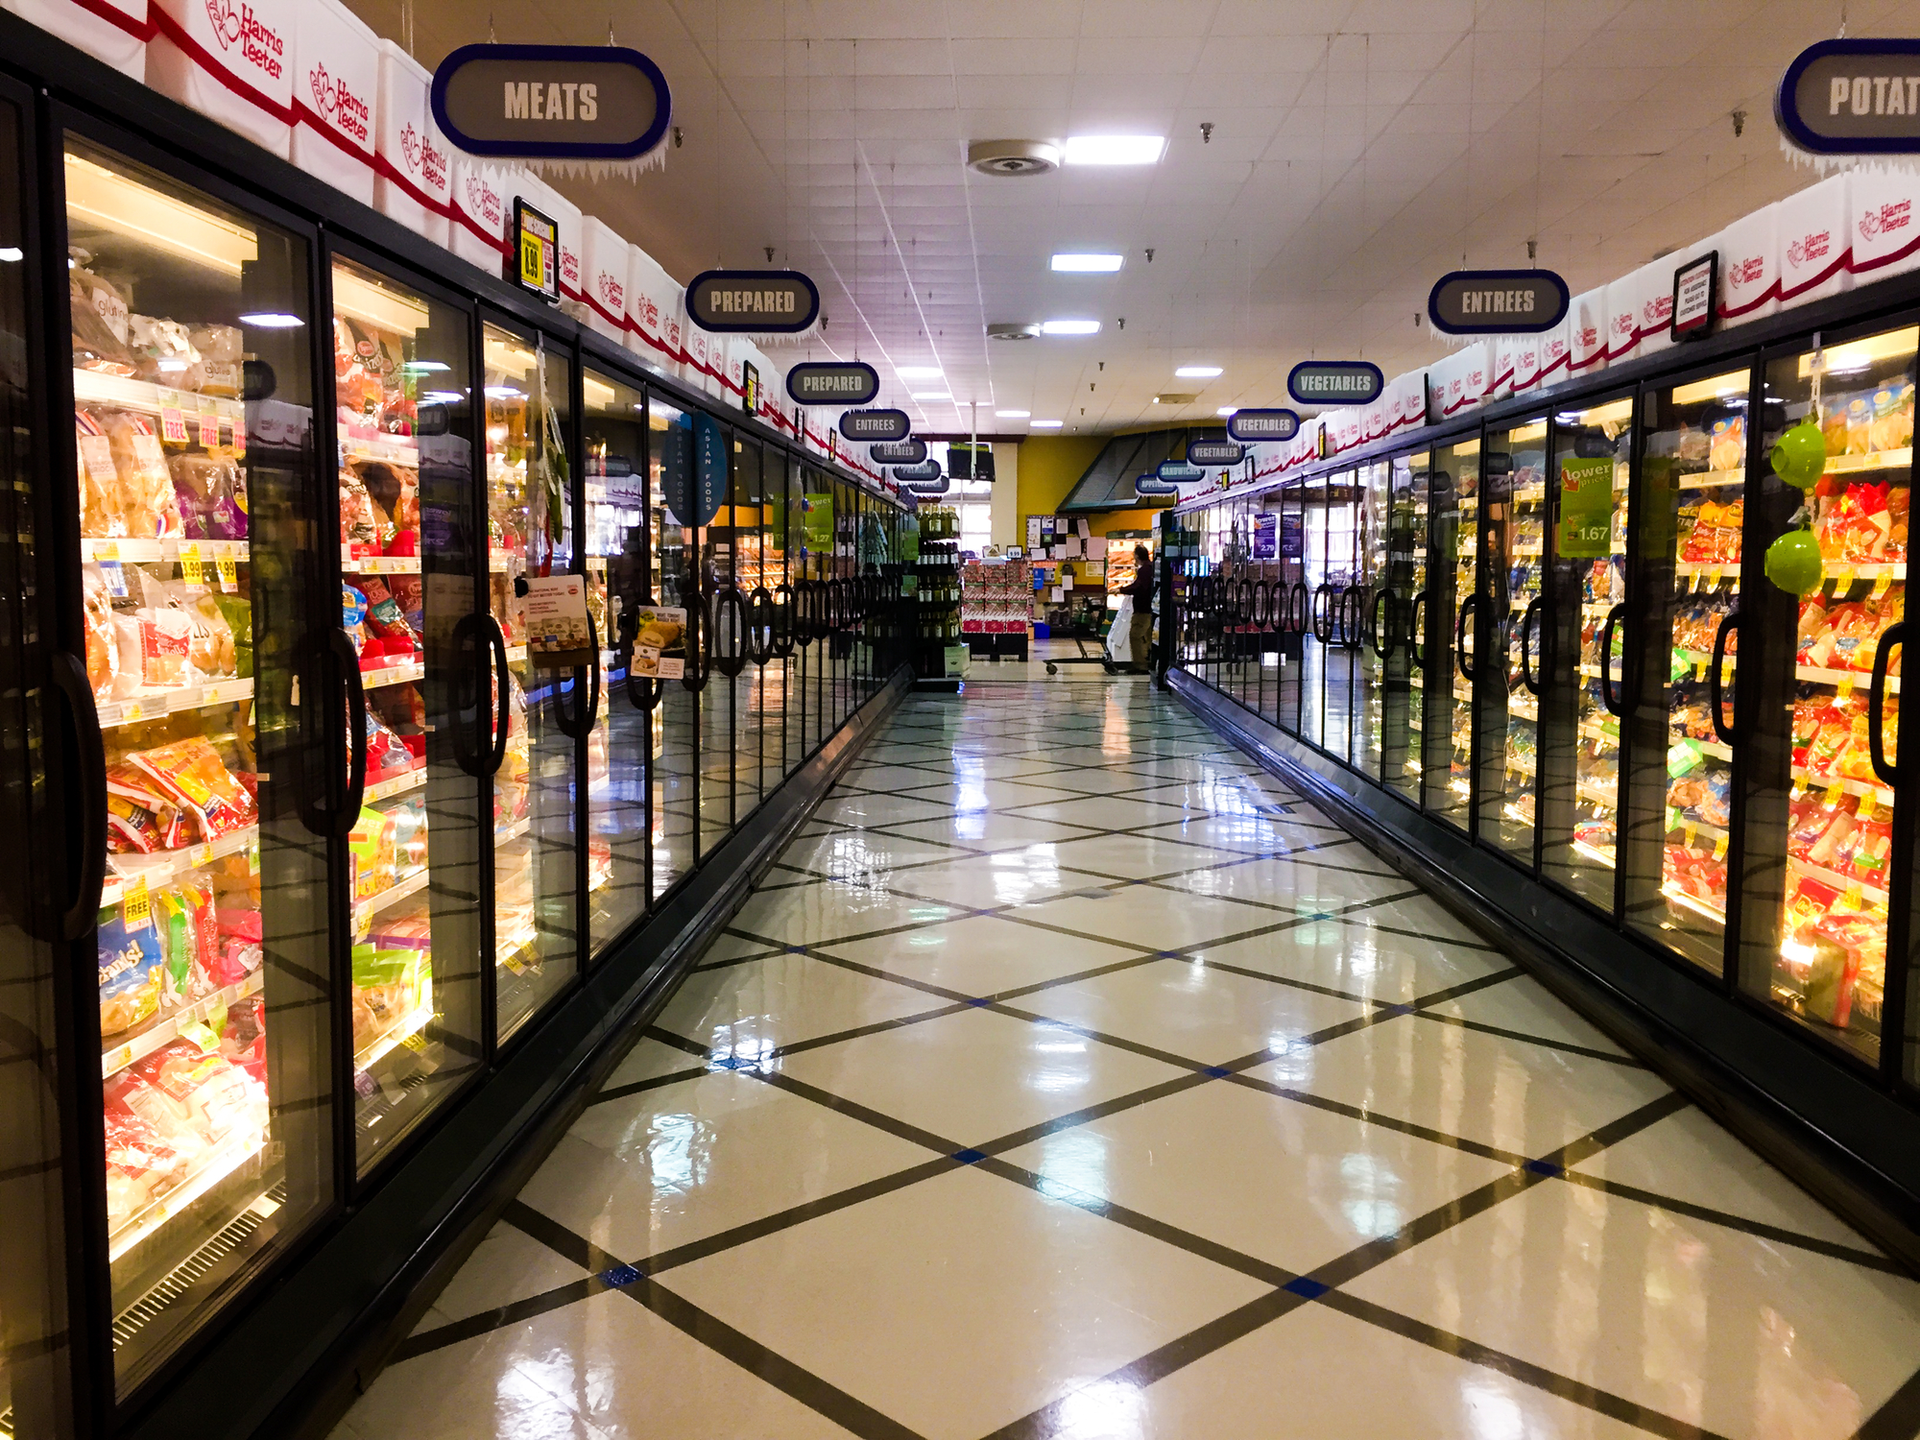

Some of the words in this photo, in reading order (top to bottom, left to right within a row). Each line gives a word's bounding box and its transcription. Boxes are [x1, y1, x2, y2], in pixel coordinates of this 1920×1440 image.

[241, 3, 284, 57] Harris
[240, 30, 283, 80] Teeter
[337, 78, 369, 122] Harris
[504, 82, 598, 120] MEATS
[1829, 77, 1920, 115] POTAT
[335, 101, 368, 142] Teeter
[421, 136, 447, 173] Harris
[420, 155, 446, 191] Teeter
[1880, 198, 1912, 220] Harris
[1879, 215, 1911, 234] Teeter
[1804, 230, 1830, 249] Harris
[1804, 243, 1830, 262] Teeter
[1742, 255, 1764, 271] Harris
[1742, 268, 1764, 284] Teeter
[711, 291, 795, 312] PREPARED
[1462, 290, 1535, 313] ENTREES
[803, 376, 862, 392] PREPARED
[1301, 375, 1371, 391] VEGETABLES
[165, 421, 186, 440] FREE
[855, 419, 895, 431] ENTREES
[1237, 419, 1290, 432] VEGETABLES
[202, 427, 218, 446] FREE
[883, 446, 915, 456] ENTREES
[1194, 448, 1238, 457] VEGETABLES
[1566, 464, 1611, 481] lower
[807, 497, 832, 507] ower
[813, 534, 830, 542] 1.27
[1579, 527, 1609, 541] 1.67
[184, 561, 201, 578] 3.99
[126, 900, 149, 919] FREE
